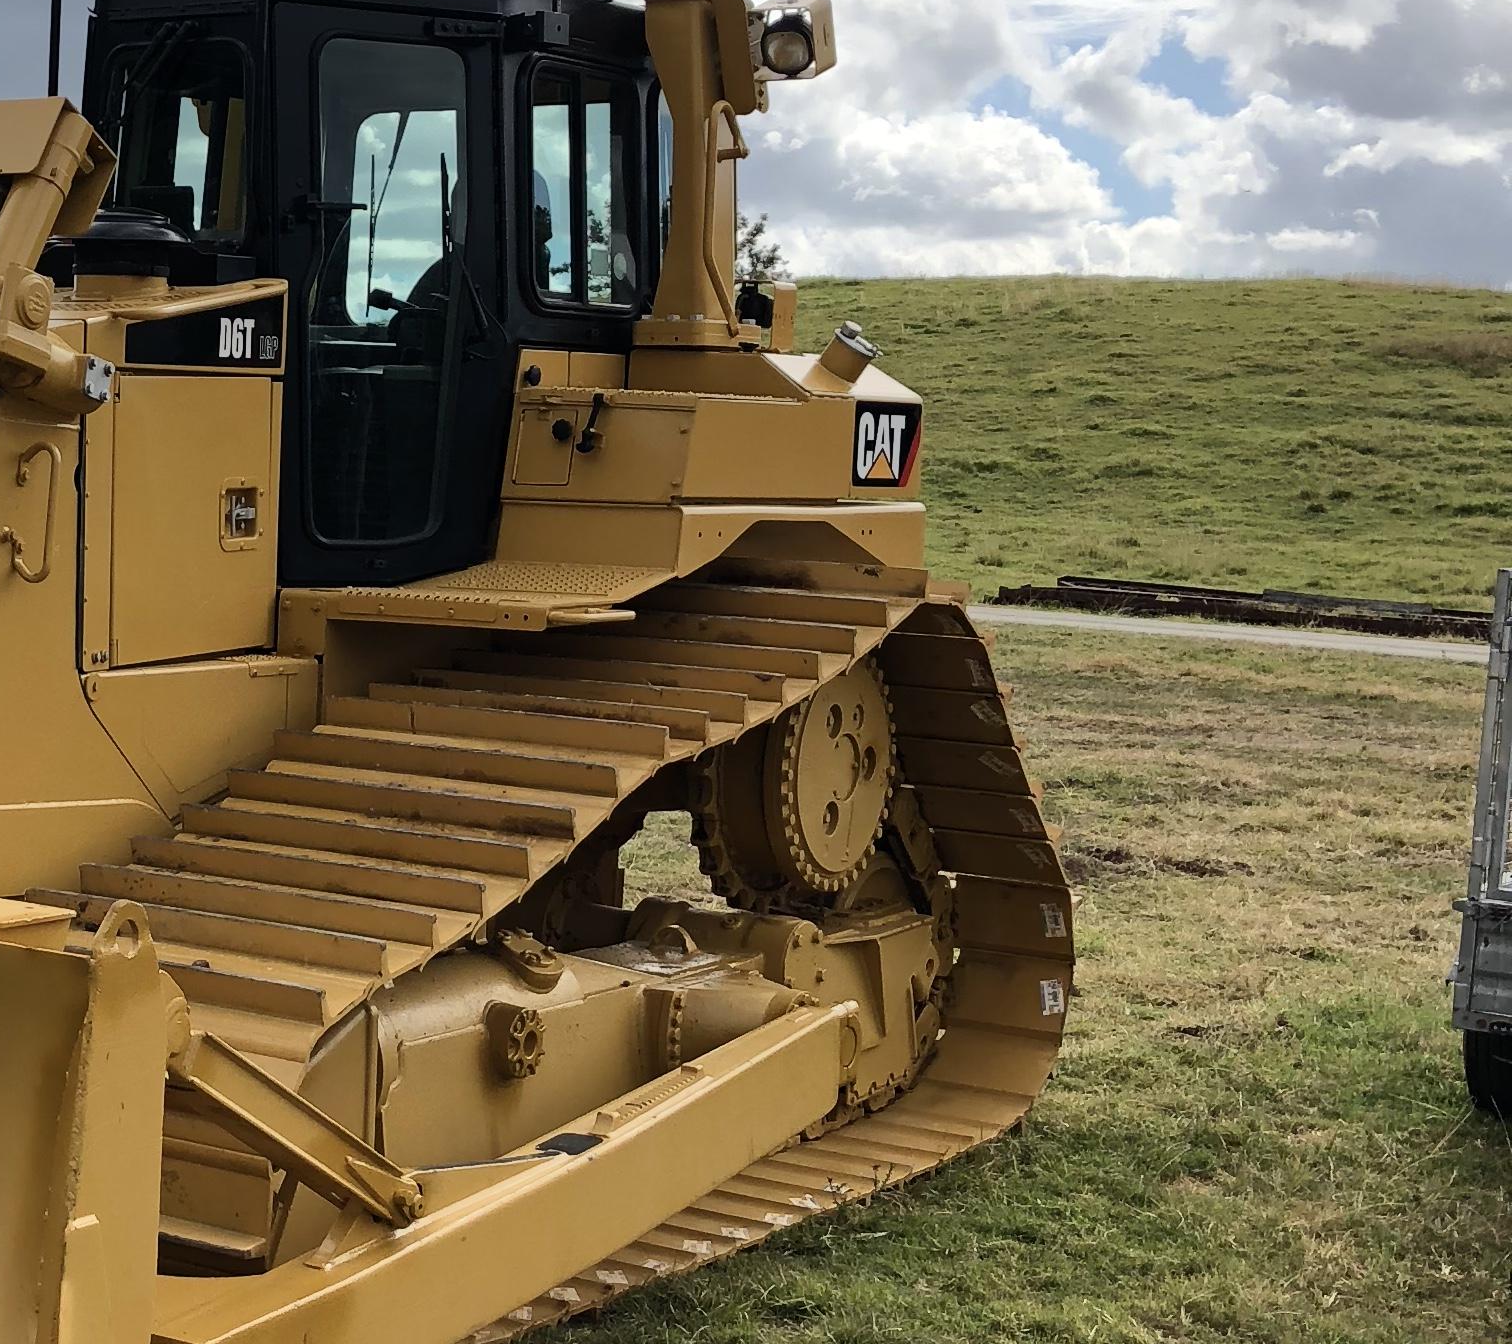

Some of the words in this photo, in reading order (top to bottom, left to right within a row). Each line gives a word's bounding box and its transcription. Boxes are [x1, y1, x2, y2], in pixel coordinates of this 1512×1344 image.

[219, 317, 256, 359] D6T
[259, 335, 279, 359] LGP
[856, 411, 906, 480] CAT
